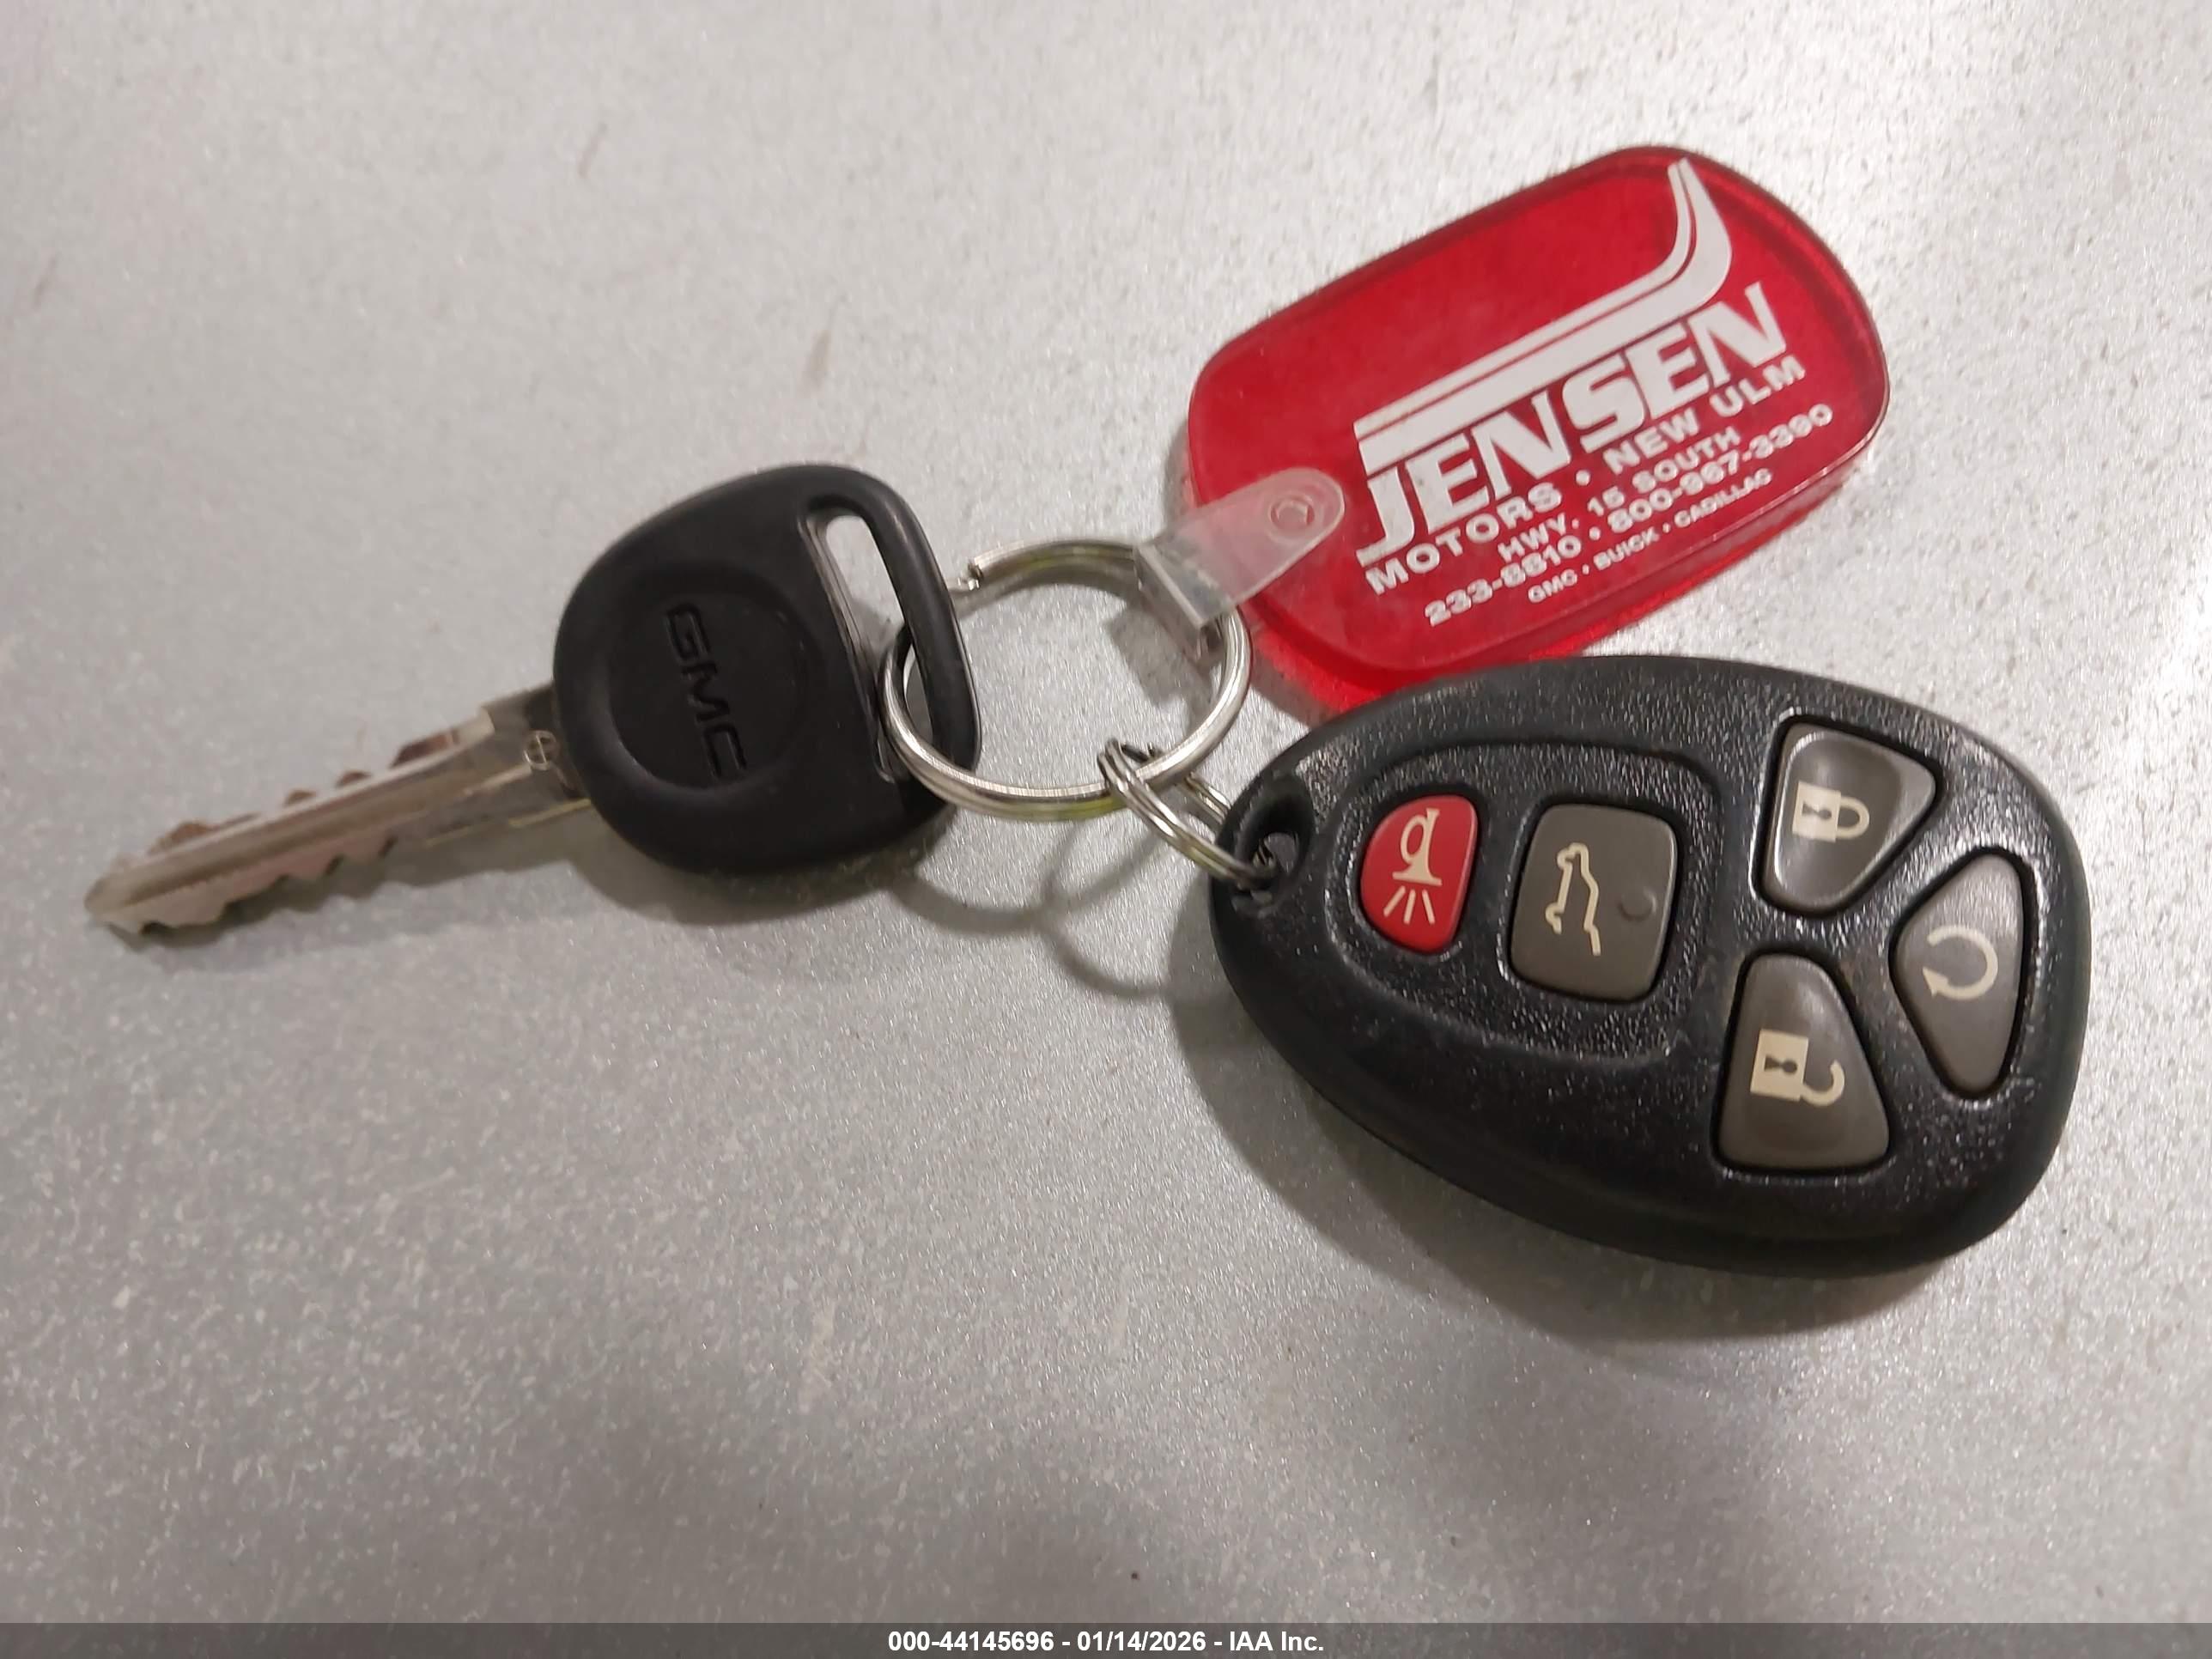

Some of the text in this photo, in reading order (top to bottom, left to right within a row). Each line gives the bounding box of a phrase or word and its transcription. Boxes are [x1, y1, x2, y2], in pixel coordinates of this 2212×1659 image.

[1356, 281, 1787, 568] JENSEN
[1365, 355, 1806, 595] MOTORS NEW ULM
[1587, 485, 1626, 517] 15
[1632, 426, 1741, 494] SOUTH
[1425, 535, 1582, 627] 233-8810
[1528, 468, 1772, 603] GMC BUICK CADILLAC
[665, 605, 748, 778] GMC
